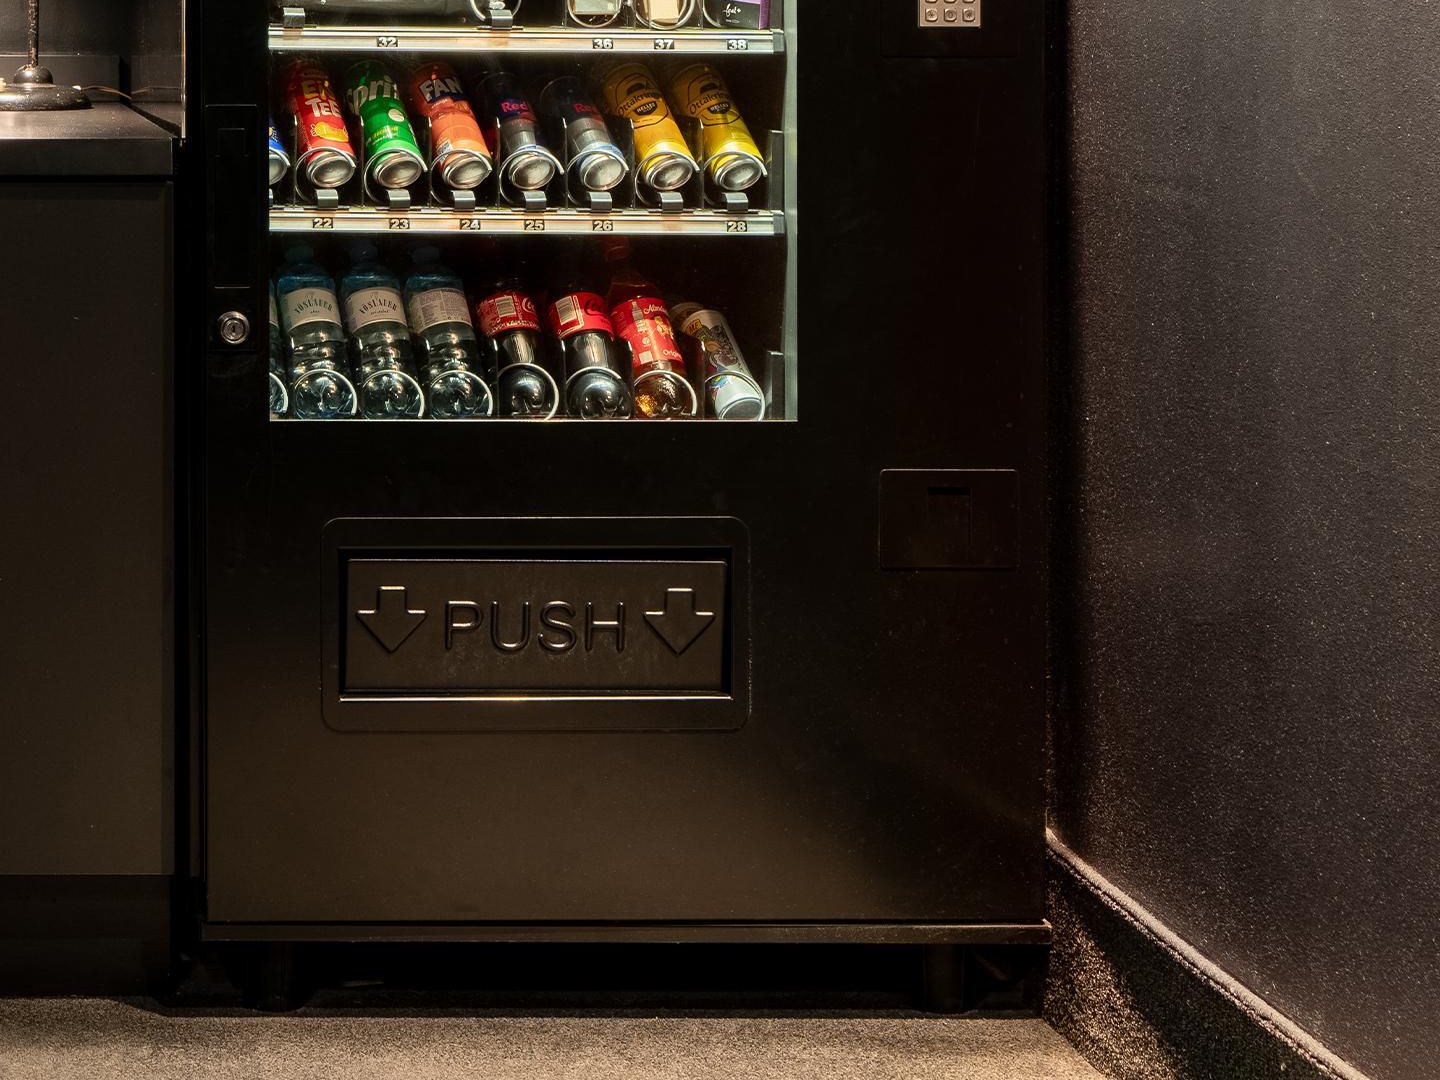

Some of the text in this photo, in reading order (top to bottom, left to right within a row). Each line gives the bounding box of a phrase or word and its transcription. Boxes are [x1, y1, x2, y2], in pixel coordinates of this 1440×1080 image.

[379, 37, 746, 50] 32 36 37 38
[420, 79, 463, 103] FAN
[305, 97, 345, 118] TEE
[314, 218, 747, 231] 22 23 24 25 26 28
[445, 601, 625, 653] PUSH
